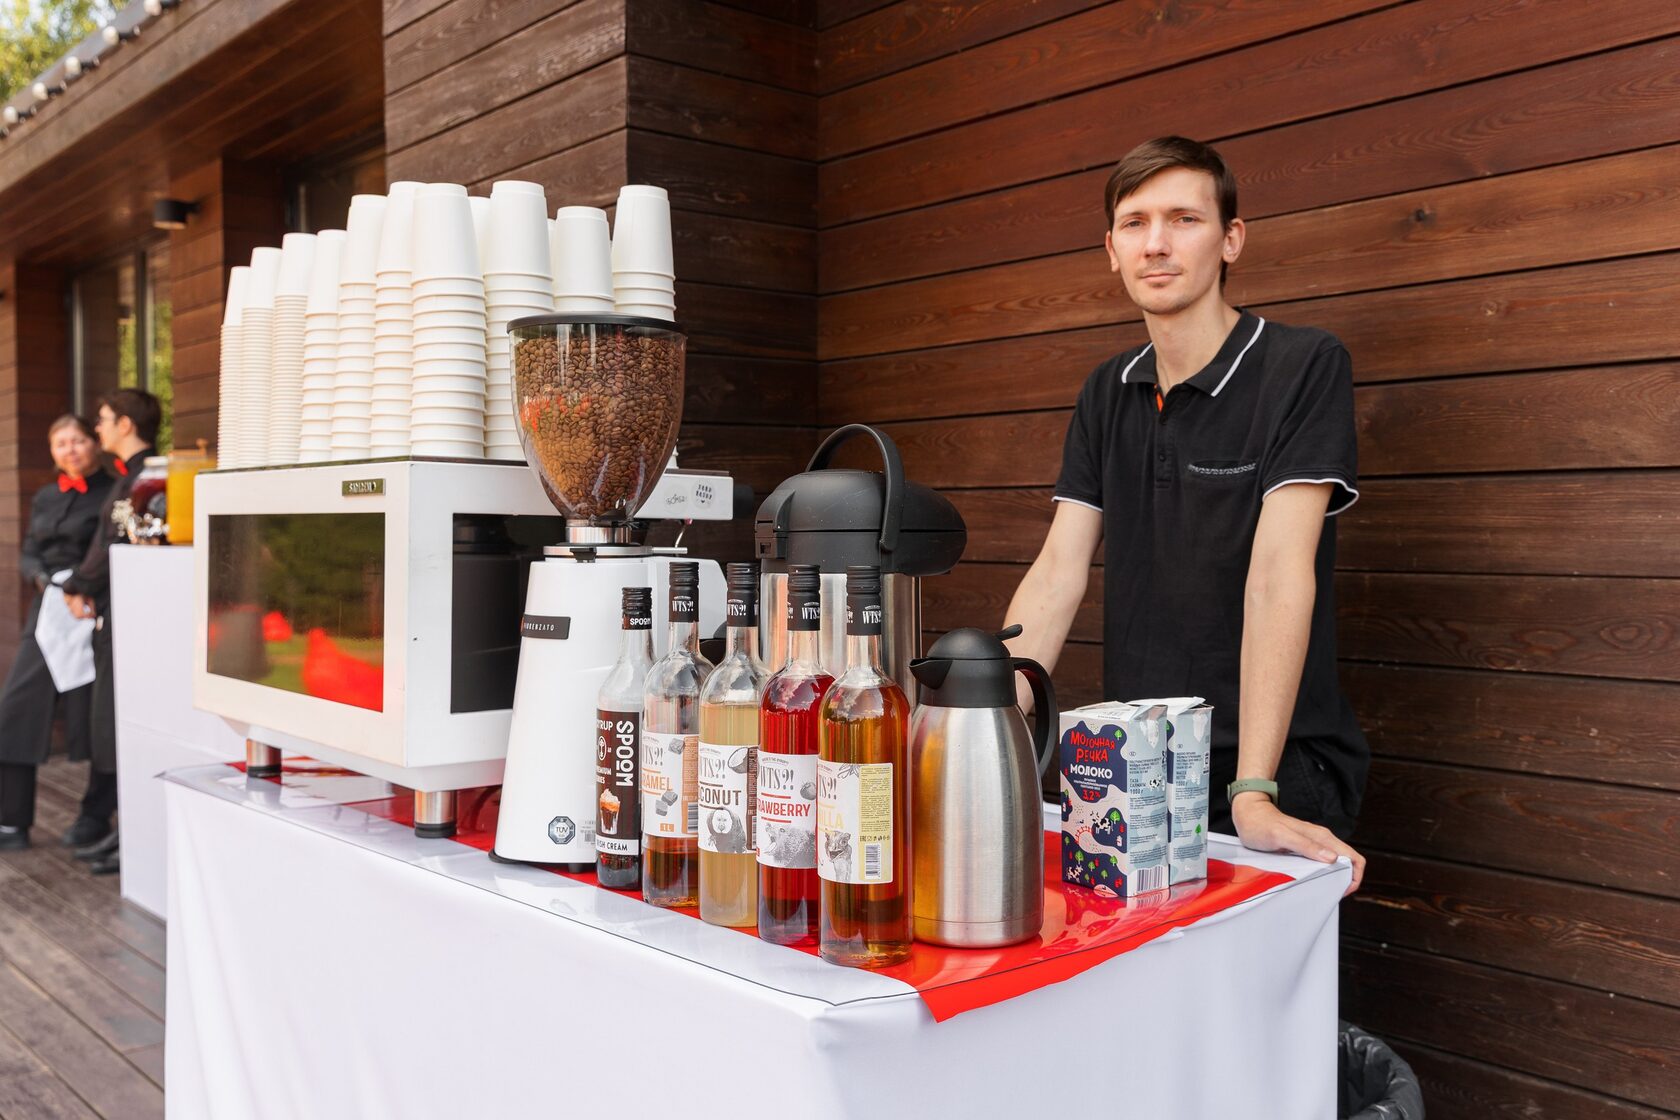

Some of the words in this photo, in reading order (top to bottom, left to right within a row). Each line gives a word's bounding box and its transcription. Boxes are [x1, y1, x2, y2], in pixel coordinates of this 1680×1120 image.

[615, 720, 634, 787] SPOOM
[1075, 747, 1109, 764] РЕЧКА
[1070, 763, 1113, 780] МОЛОКО
[641, 774, 673, 791] RAMEL
[699, 786, 742, 806] CONUT
[757, 798, 811, 817] RAWBERRY
[606, 842, 628, 851] CREAM
